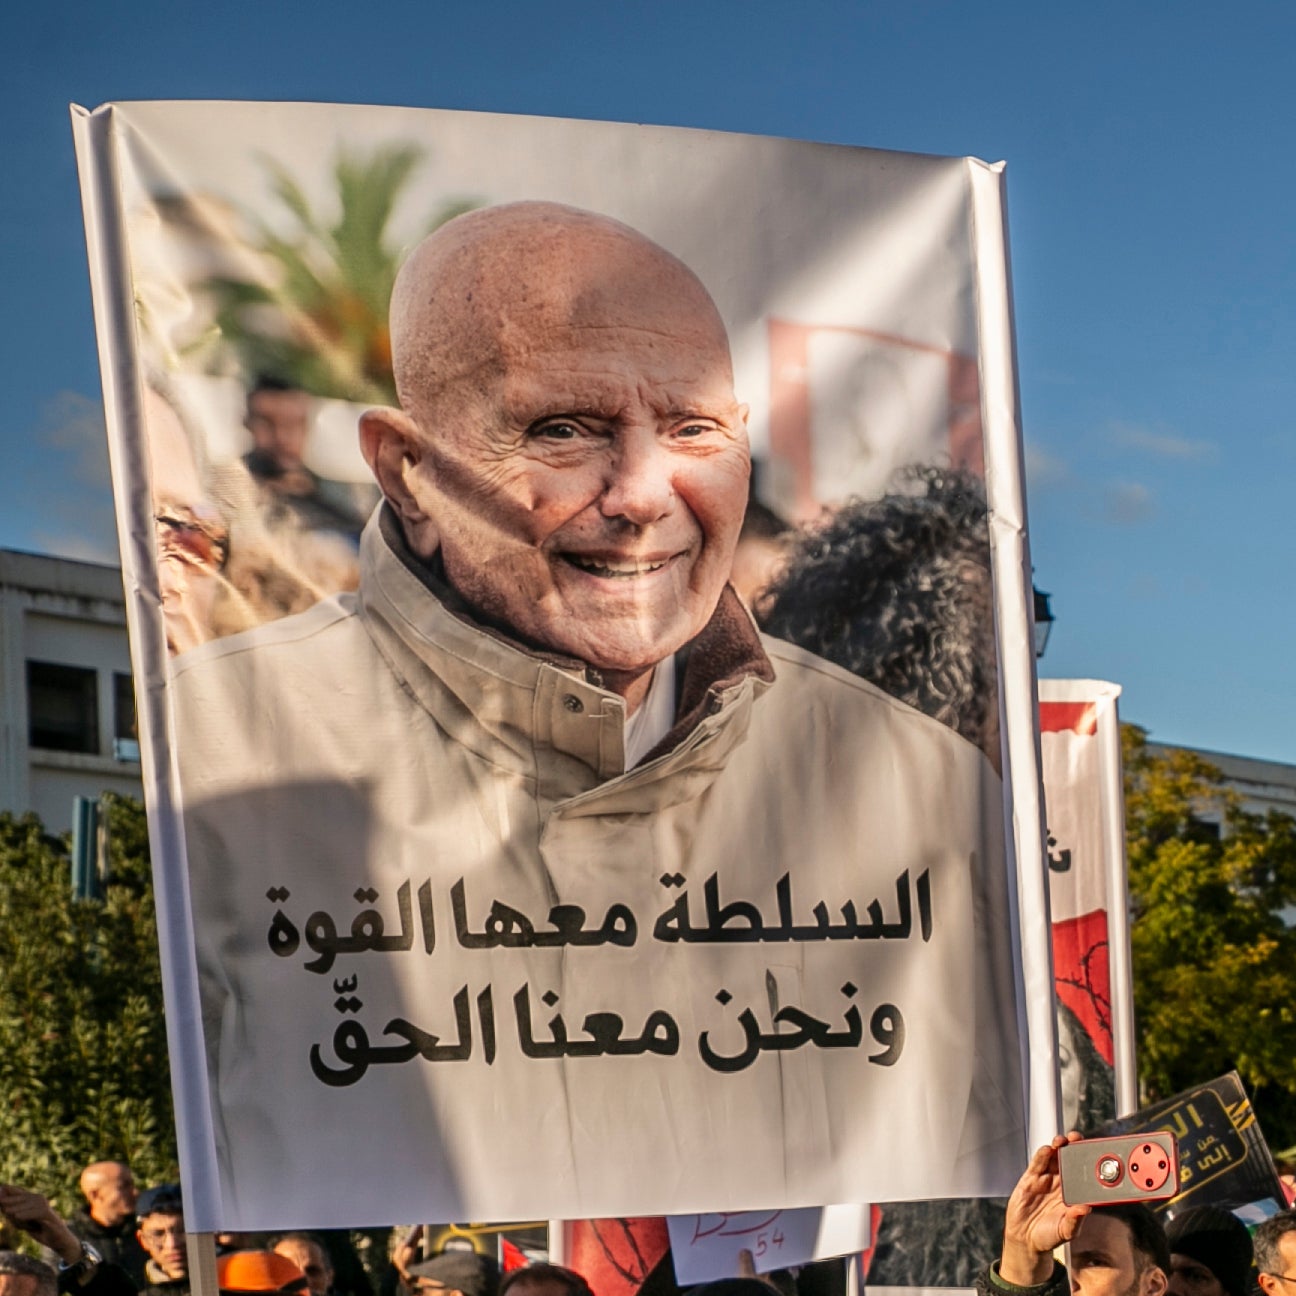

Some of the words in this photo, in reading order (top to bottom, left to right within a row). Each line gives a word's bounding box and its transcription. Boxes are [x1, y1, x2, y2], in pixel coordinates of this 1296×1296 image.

[266, 877, 434, 975] القوة
[450, 876, 637, 951] معها
[653, 867, 931, 944] السلطة
[310, 974, 496, 1088] الحقّ
[513, 982, 680, 1060] معنا
[698, 980, 905, 1074] ونحن
[754, 1230, 785, 1257] 54
